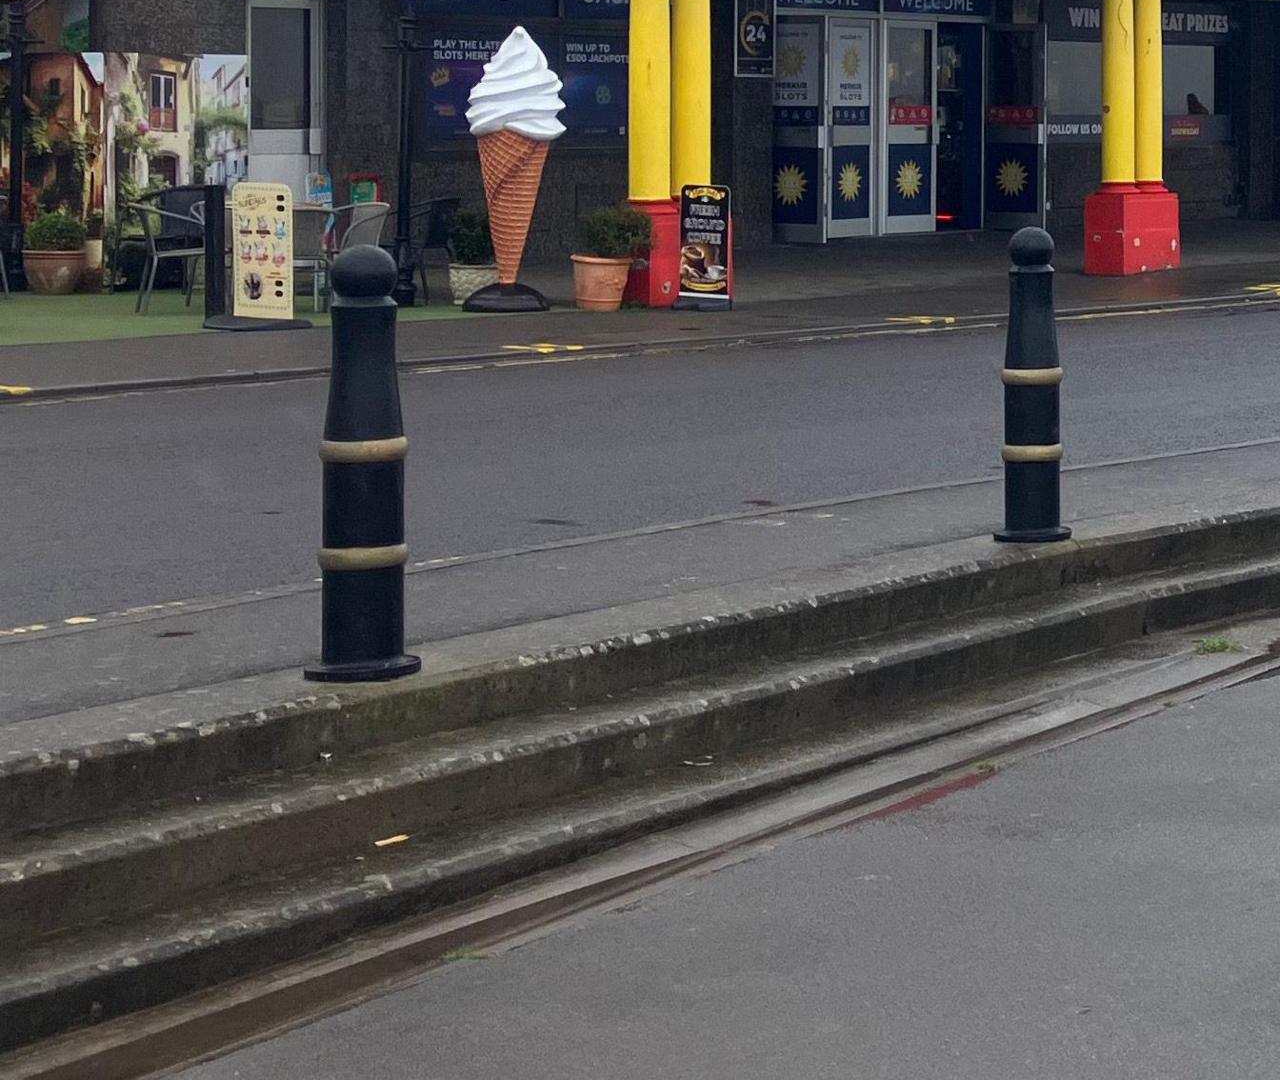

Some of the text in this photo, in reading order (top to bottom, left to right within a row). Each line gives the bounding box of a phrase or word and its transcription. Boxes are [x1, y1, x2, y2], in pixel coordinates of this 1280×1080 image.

[1186, 14, 1229, 33] PRIZES
[746, 25, 766, 43] 24
[433, 39, 456, 49] PLAY
[458, 40, 477, 50] THE
[566, 43, 610, 53] WIN UP TO
[433, 50, 463, 60] SLOTS
[464, 51, 488, 61] HERE
[1048, 123, 1079, 135] FOLLOW
